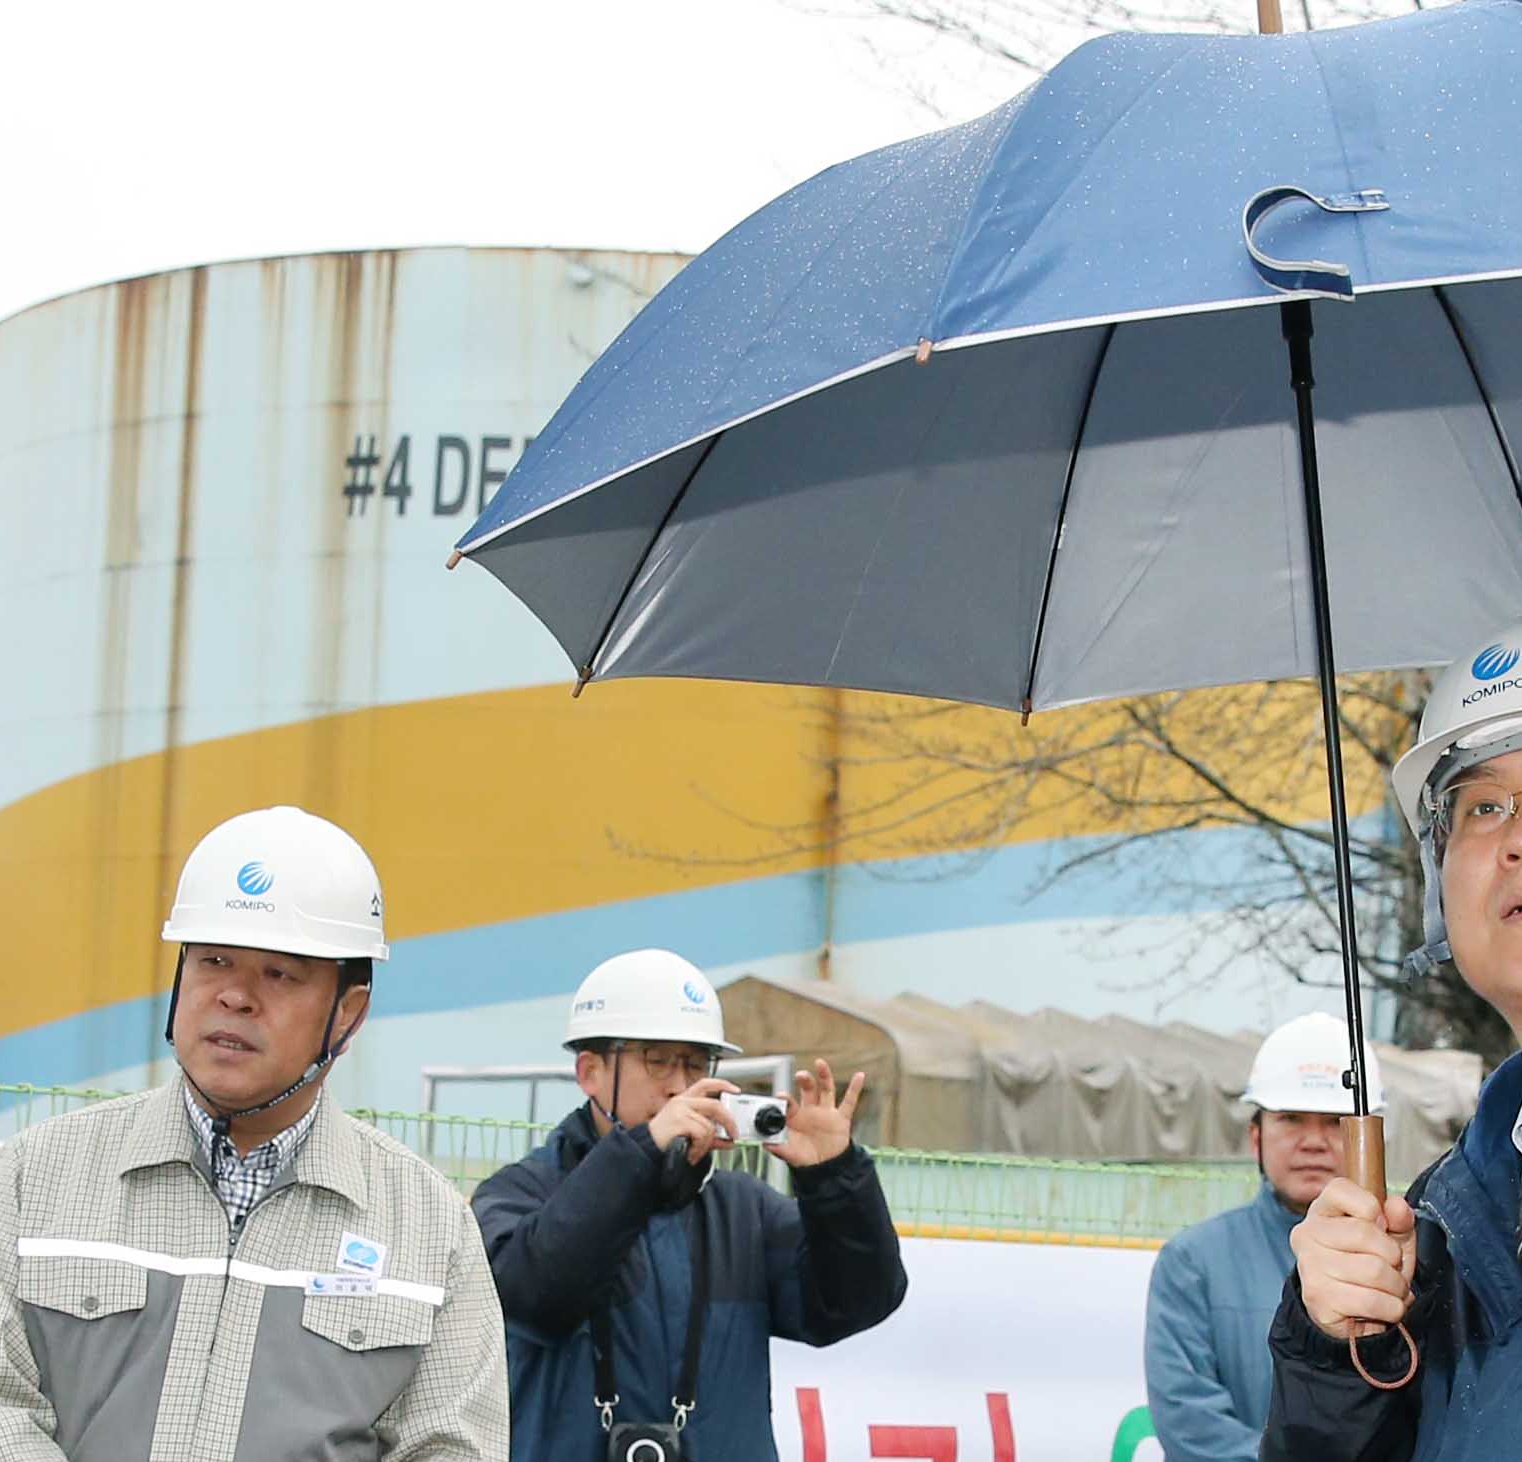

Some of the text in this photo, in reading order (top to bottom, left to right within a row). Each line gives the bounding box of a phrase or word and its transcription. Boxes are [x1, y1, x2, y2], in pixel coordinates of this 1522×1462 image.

[342, 433, 537, 517] #4 DE
[224, 898, 276, 914] KOMIPO
